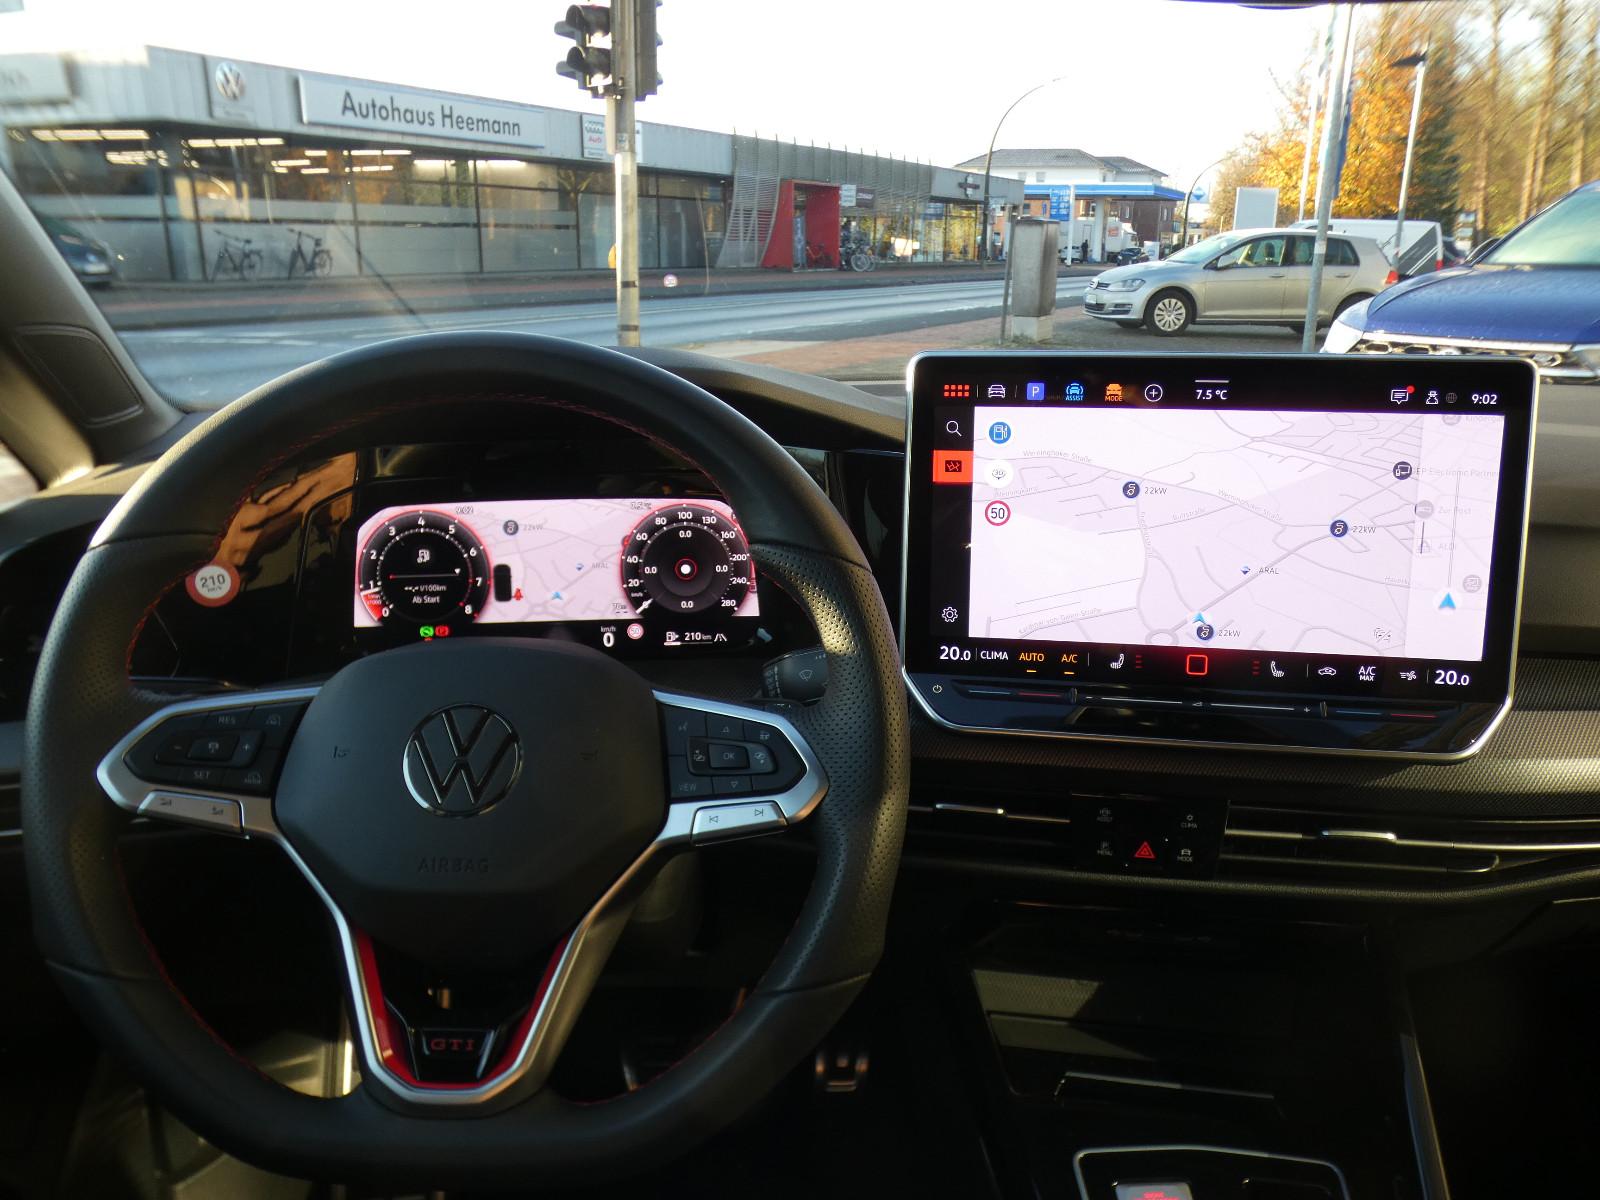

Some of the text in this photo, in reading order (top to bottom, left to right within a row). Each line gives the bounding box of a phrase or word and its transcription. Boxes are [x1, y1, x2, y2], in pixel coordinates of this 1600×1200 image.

[341, 89, 521, 136] Autohaus Heemann
[1196, 389, 1228, 400] 7.5 °C
[1472, 393, 1497, 405] 9:02
[1144, 487, 1167, 495] 22kW
[677, 511, 693, 519] 100
[990, 507, 1005, 519] 50
[417, 516, 425, 526] 4
[655, 517, 667, 525] 80
[702, 516, 716, 524] 130
[388, 526, 396, 536] 3
[448, 524, 455, 534] 5
[636, 533, 648, 541] 60
[720, 531, 736, 539] 160
[370, 550, 377, 560] 2
[469, 547, 477, 557] 6
[627, 556, 639, 564] 40
[716, 565, 728, 573] 0.0
[1258, 567, 1279, 575] ARAL
[200, 573, 226, 589] 210
[475, 577, 482, 587] 7
[628, 579, 639, 587] 20
[732, 576, 747, 584] 240
[412, 595, 440, 604] Ab Start
[721, 599, 736, 607] 280
[382, 607, 389, 617] 0
[464, 605, 472, 615] 8
[684, 633, 701, 641] 210
[1218, 629, 1241, 637] 22kW
[602, 633, 615, 647] 0
[939, 645, 1078, 663] 20.0 CLIMA AUTO A/C
[1358, 665, 1377, 676] A/C
[1434, 669, 1470, 686] 20.0
[722, 752, 735, 760] OK
[417, 858, 489, 873] AIRBAG
[430, 1039, 475, 1051] GTI
